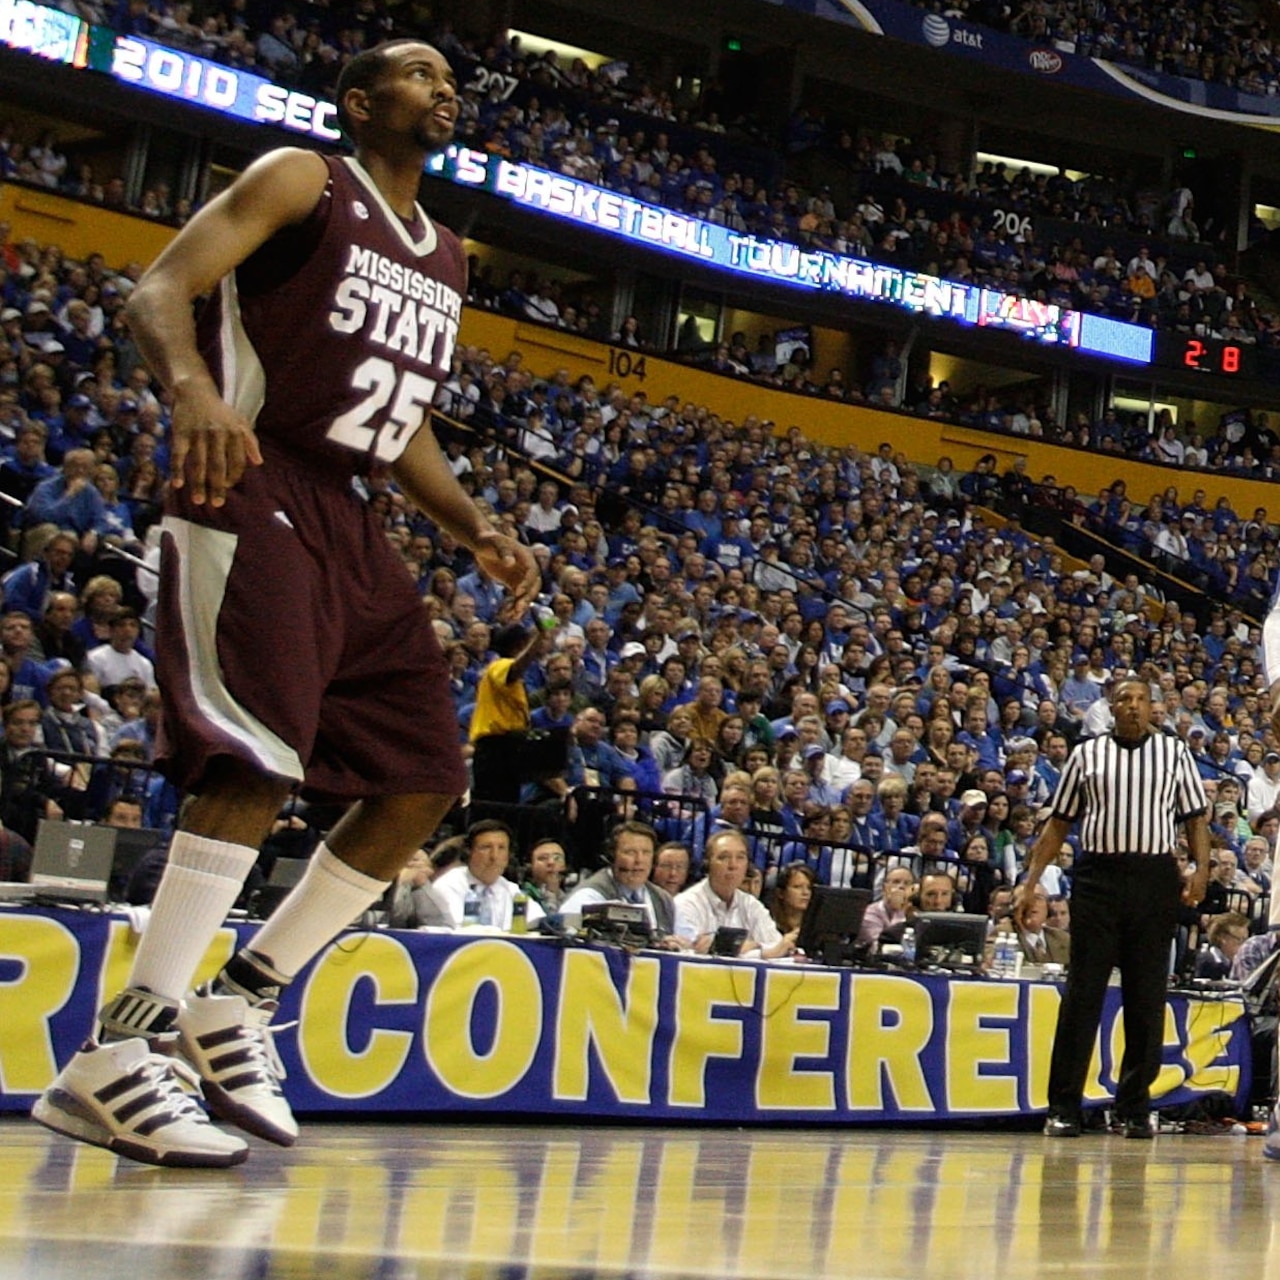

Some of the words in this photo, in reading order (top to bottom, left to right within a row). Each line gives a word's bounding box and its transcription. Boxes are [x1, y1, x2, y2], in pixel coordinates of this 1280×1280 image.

[953, 28, 983, 50] at&t
[464, 64, 520, 104] 207
[111, 36, 239, 108] 2010
[255, 83, 342, 141] SEC
[498, 160, 714, 259] BASKETBALL
[728, 232, 968, 317] TOURNAMENT
[992, 209, 1033, 238] 206
[608, 348, 648, 380] 104
[326, 356, 438, 463] 25
